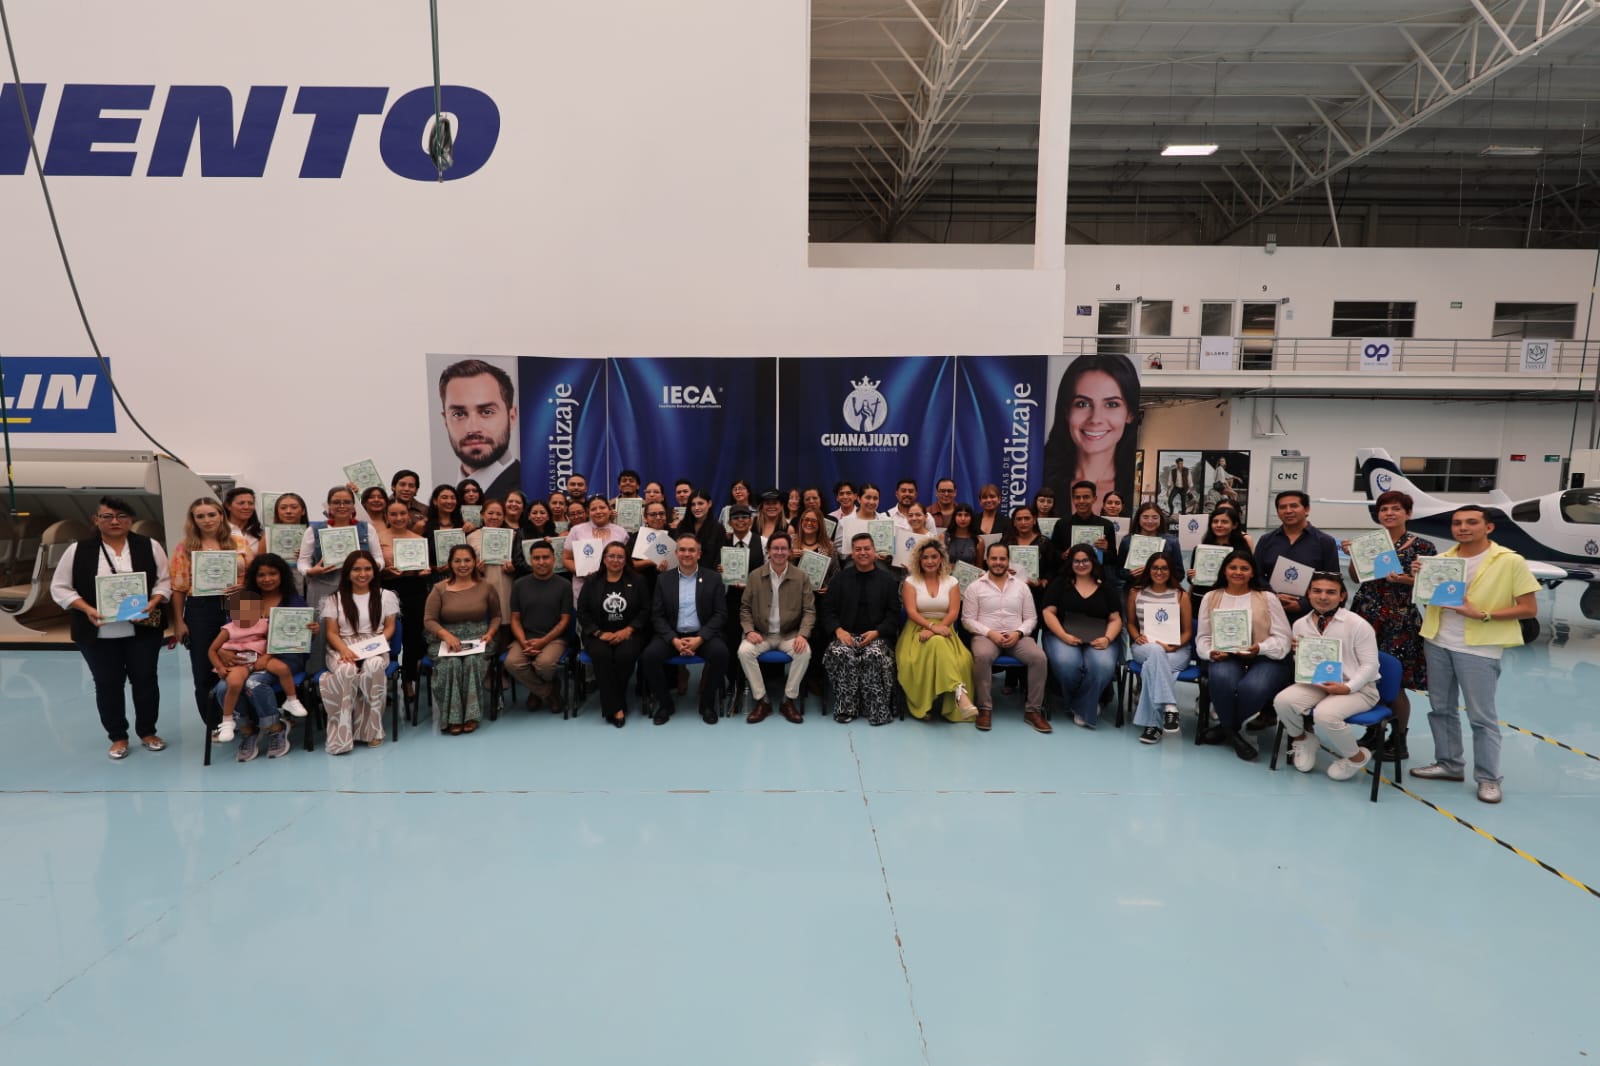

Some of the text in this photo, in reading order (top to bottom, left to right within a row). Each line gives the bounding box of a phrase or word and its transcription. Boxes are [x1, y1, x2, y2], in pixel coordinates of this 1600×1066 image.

[663, 385, 717, 405] IECA
[548, 383, 580, 493] endizaje
[820, 433, 909, 447] GUANAJUATO
[1001, 473, 1010, 517] IENCIAS
